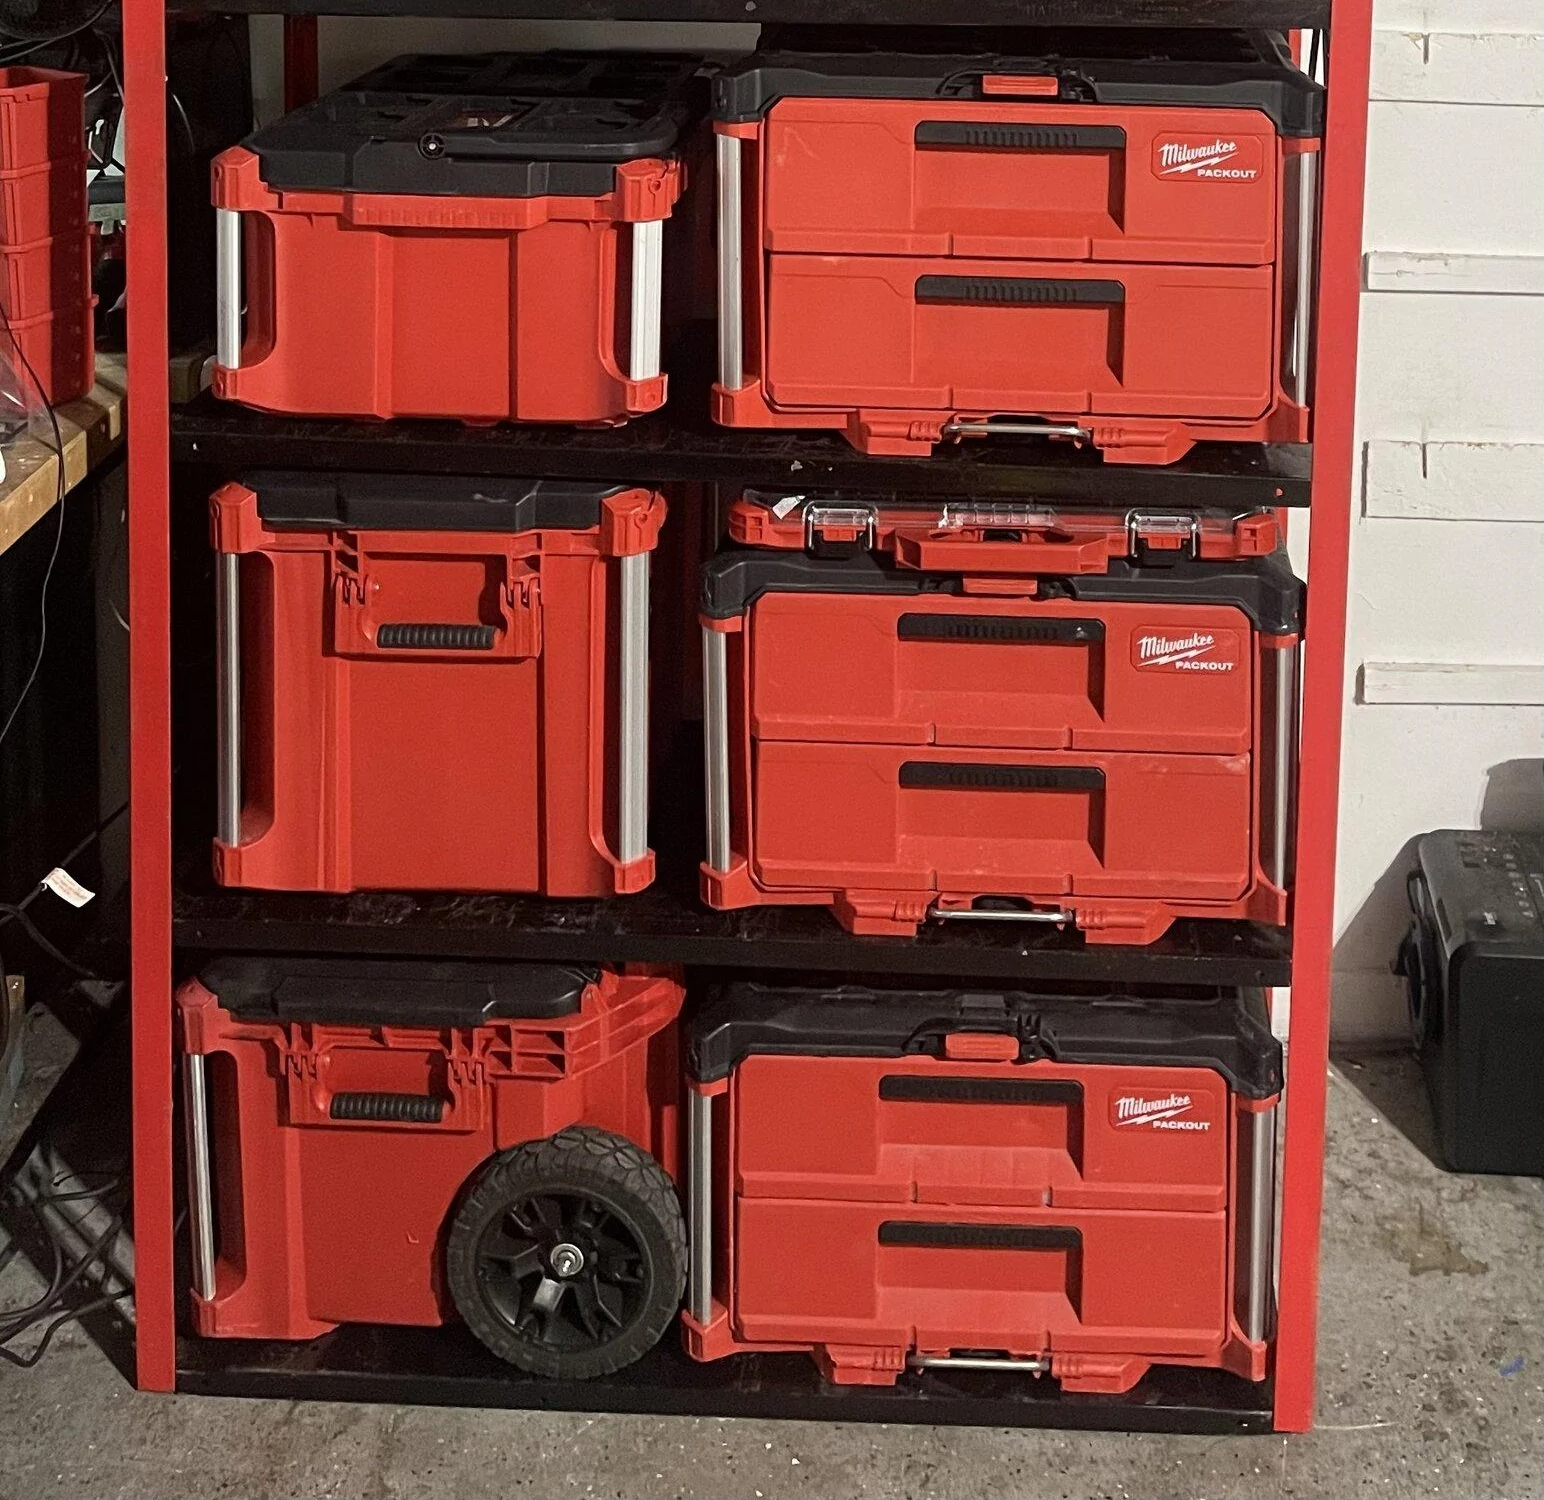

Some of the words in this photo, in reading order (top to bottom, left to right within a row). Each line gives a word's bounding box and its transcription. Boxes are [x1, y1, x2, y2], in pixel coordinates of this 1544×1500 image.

[1159, 139, 1238, 167] Milwaukee
[1197, 168, 1257, 179] PACKOUT
[1138, 632, 1215, 659] Milwaukee
[1175, 660, 1234, 671] PACKOUT
[1115, 1093, 1191, 1119] Milwaukee
[1152, 1120, 1211, 1131] PACKOUT
